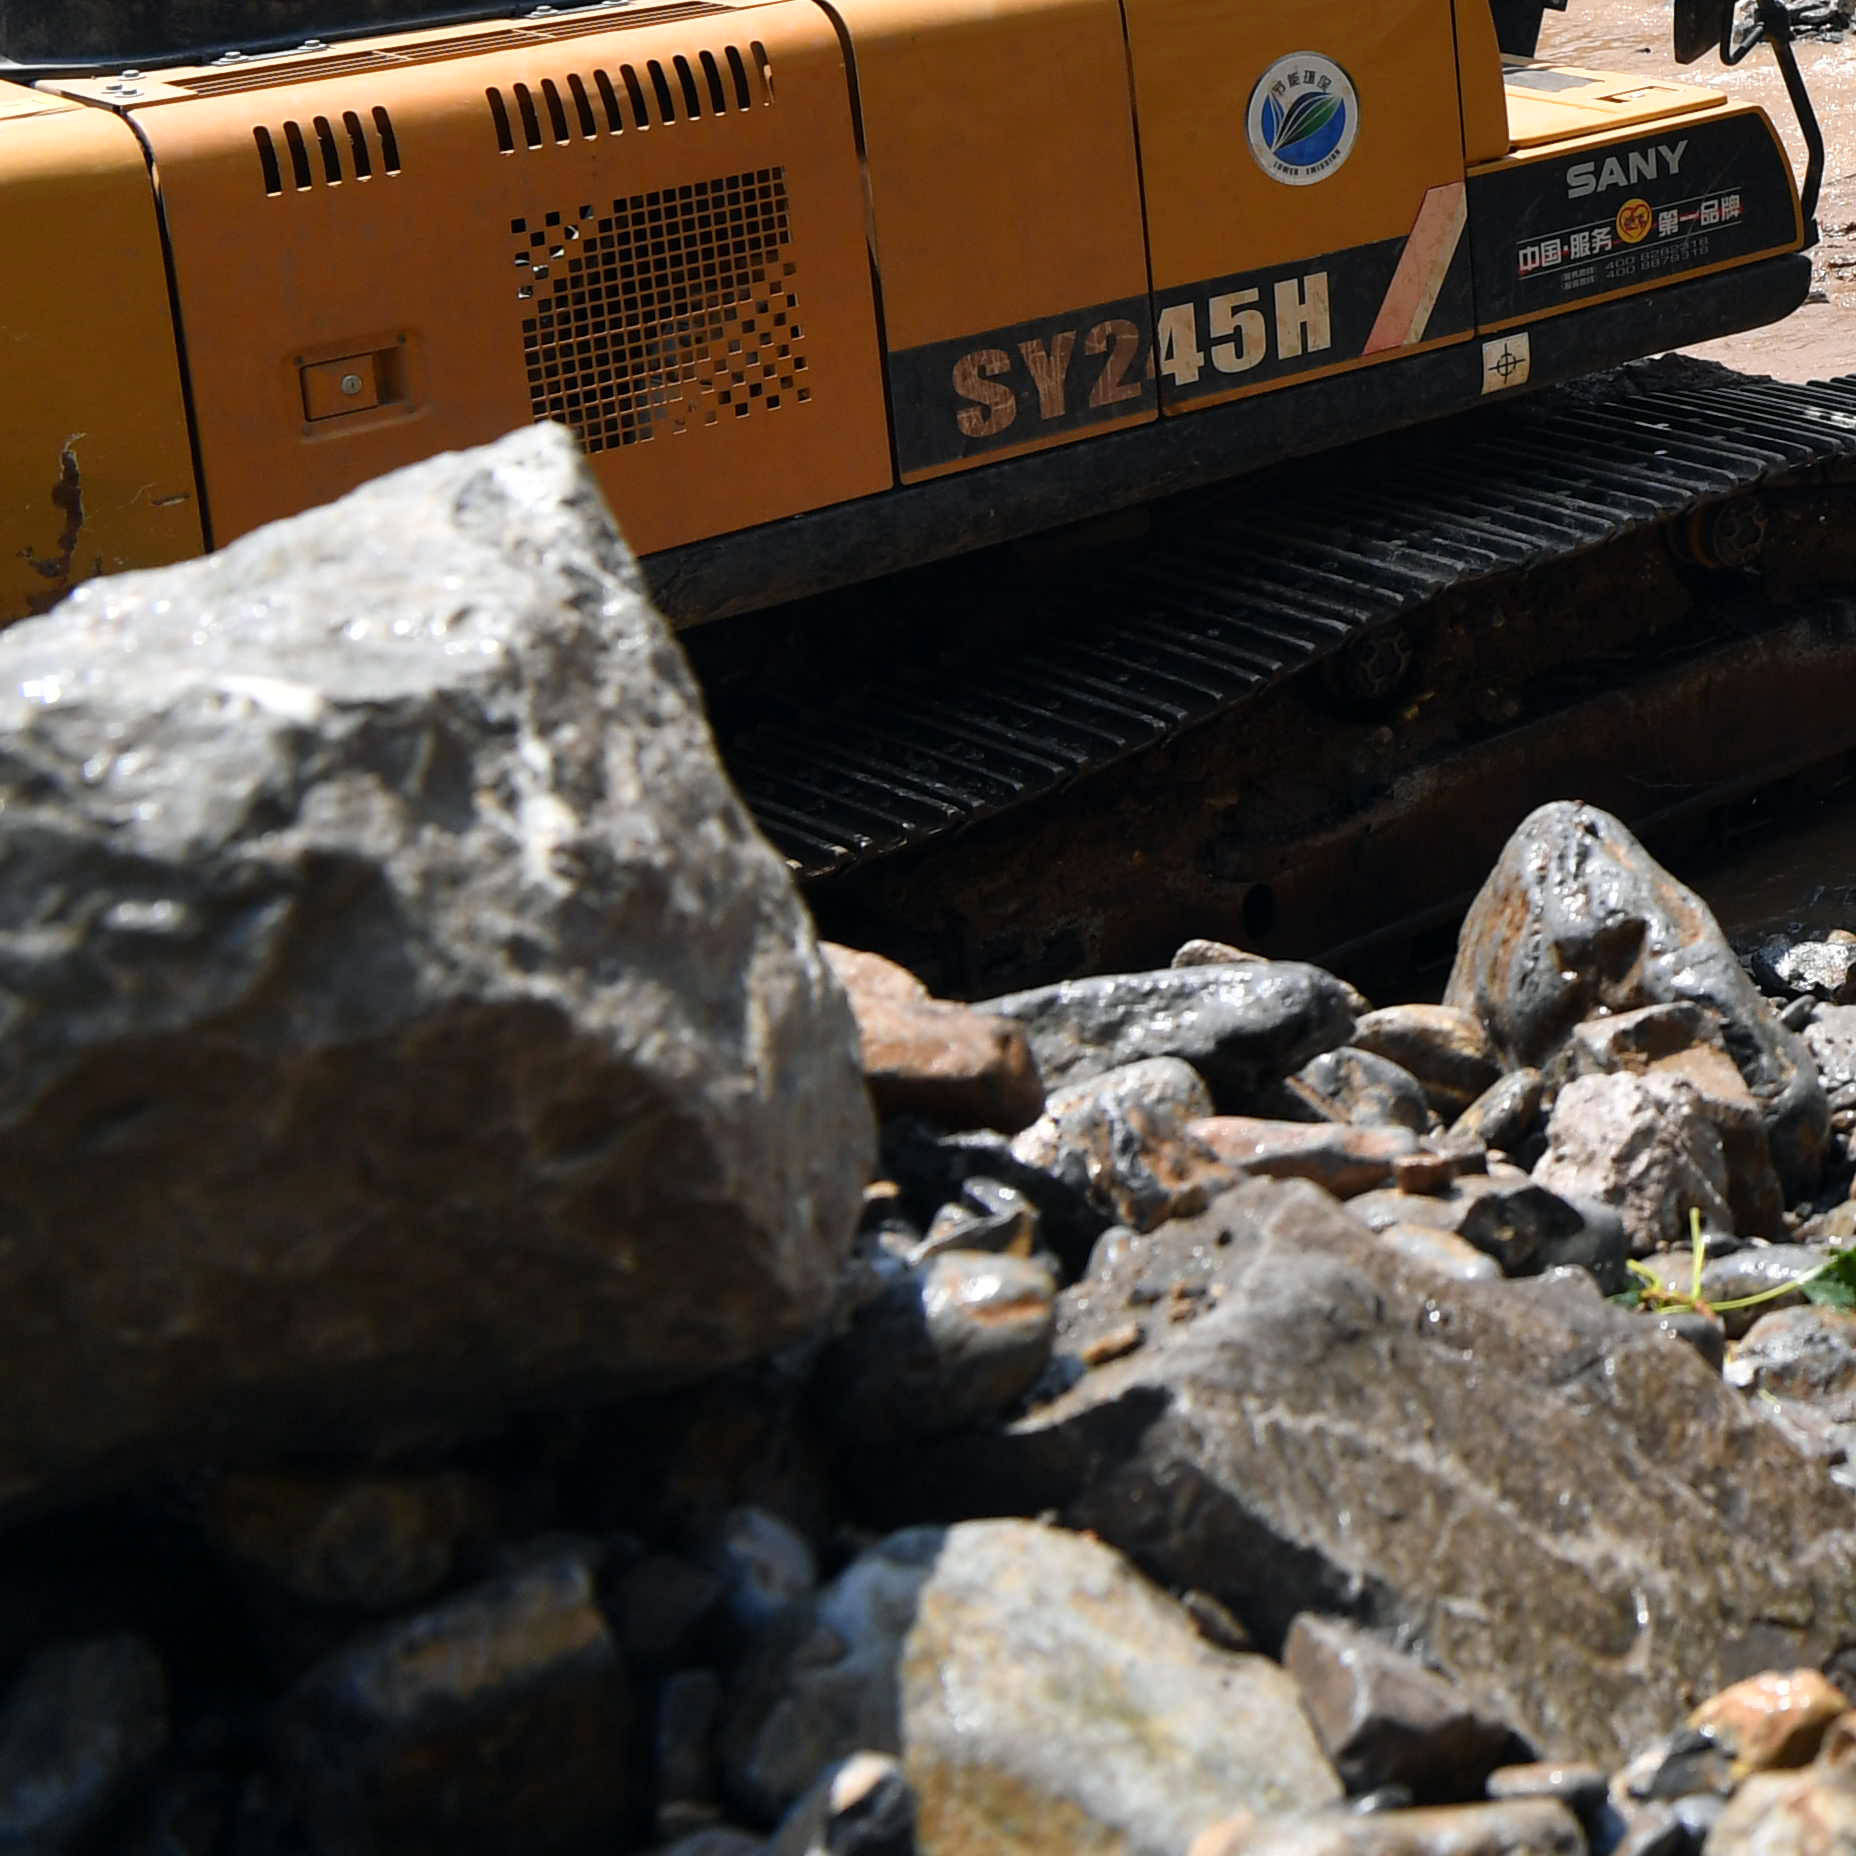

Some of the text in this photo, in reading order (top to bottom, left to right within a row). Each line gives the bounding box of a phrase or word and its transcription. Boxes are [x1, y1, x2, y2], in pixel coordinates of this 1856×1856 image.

[1566, 140, 1688, 200] SANY
[1658, 194, 1741, 238] 第一品牌
[952, 272, 1332, 438] SY245H
